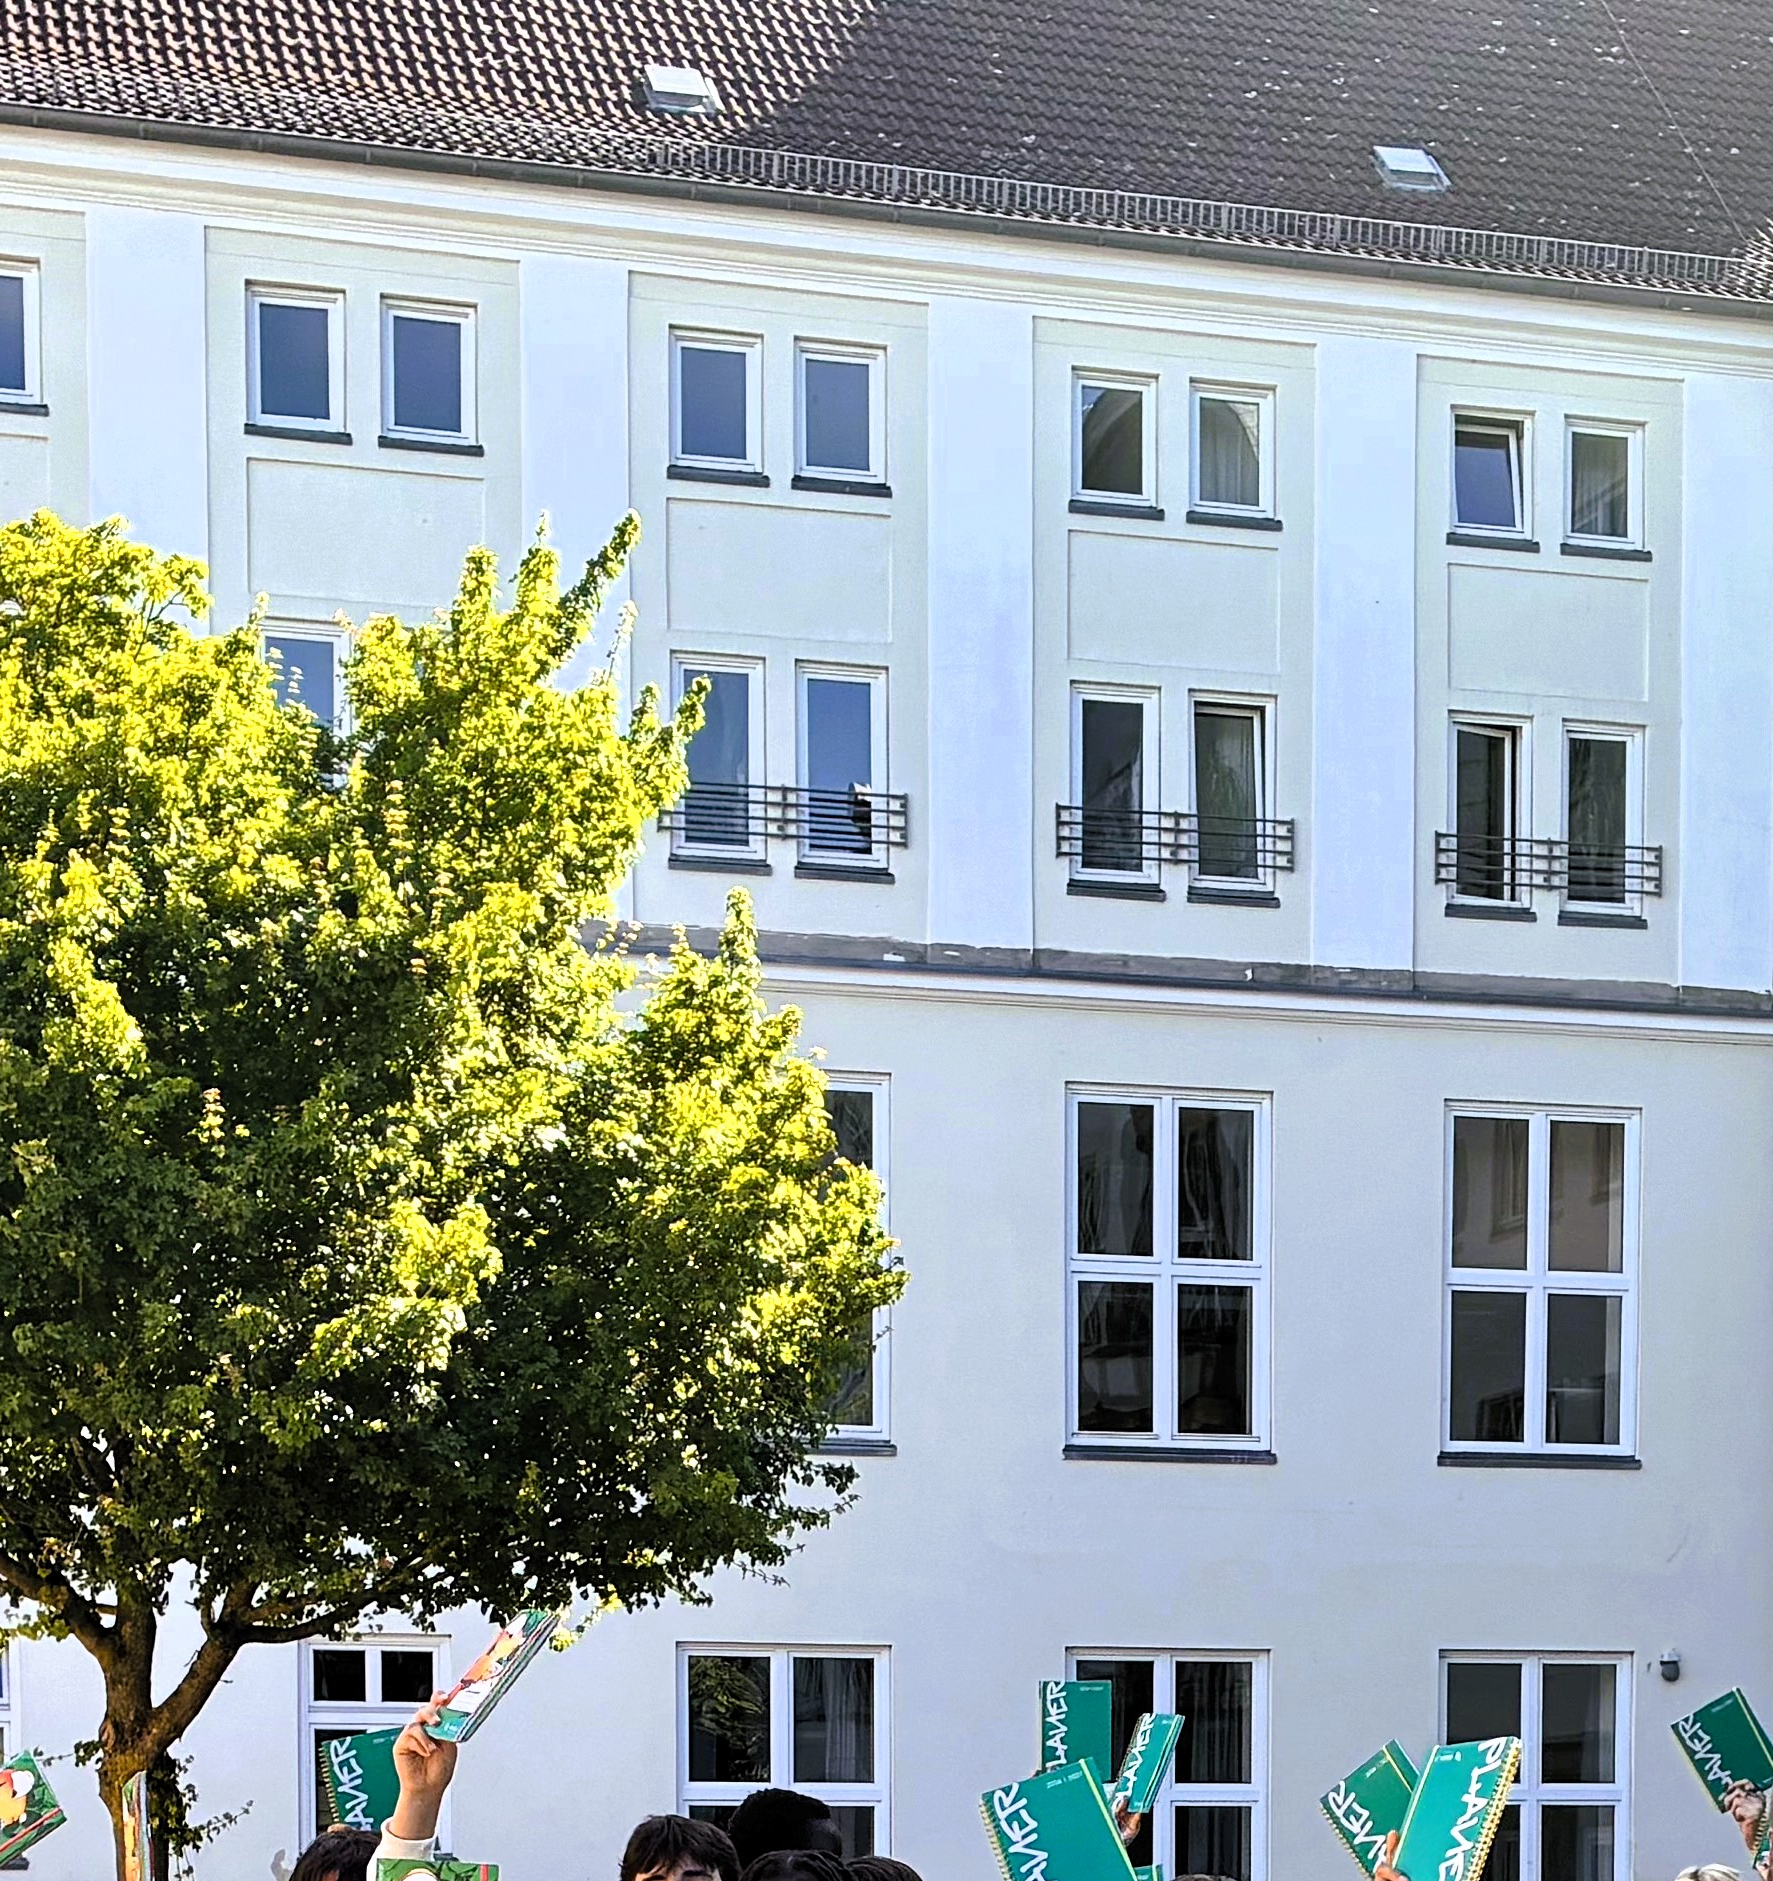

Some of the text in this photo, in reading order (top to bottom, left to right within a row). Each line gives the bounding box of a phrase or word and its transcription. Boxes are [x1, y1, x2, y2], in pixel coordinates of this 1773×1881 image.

[1045, 1679, 1069, 1773] LANER
[1679, 1713, 1733, 1800] ANER
[330, 1736, 375, 1831] ANER
